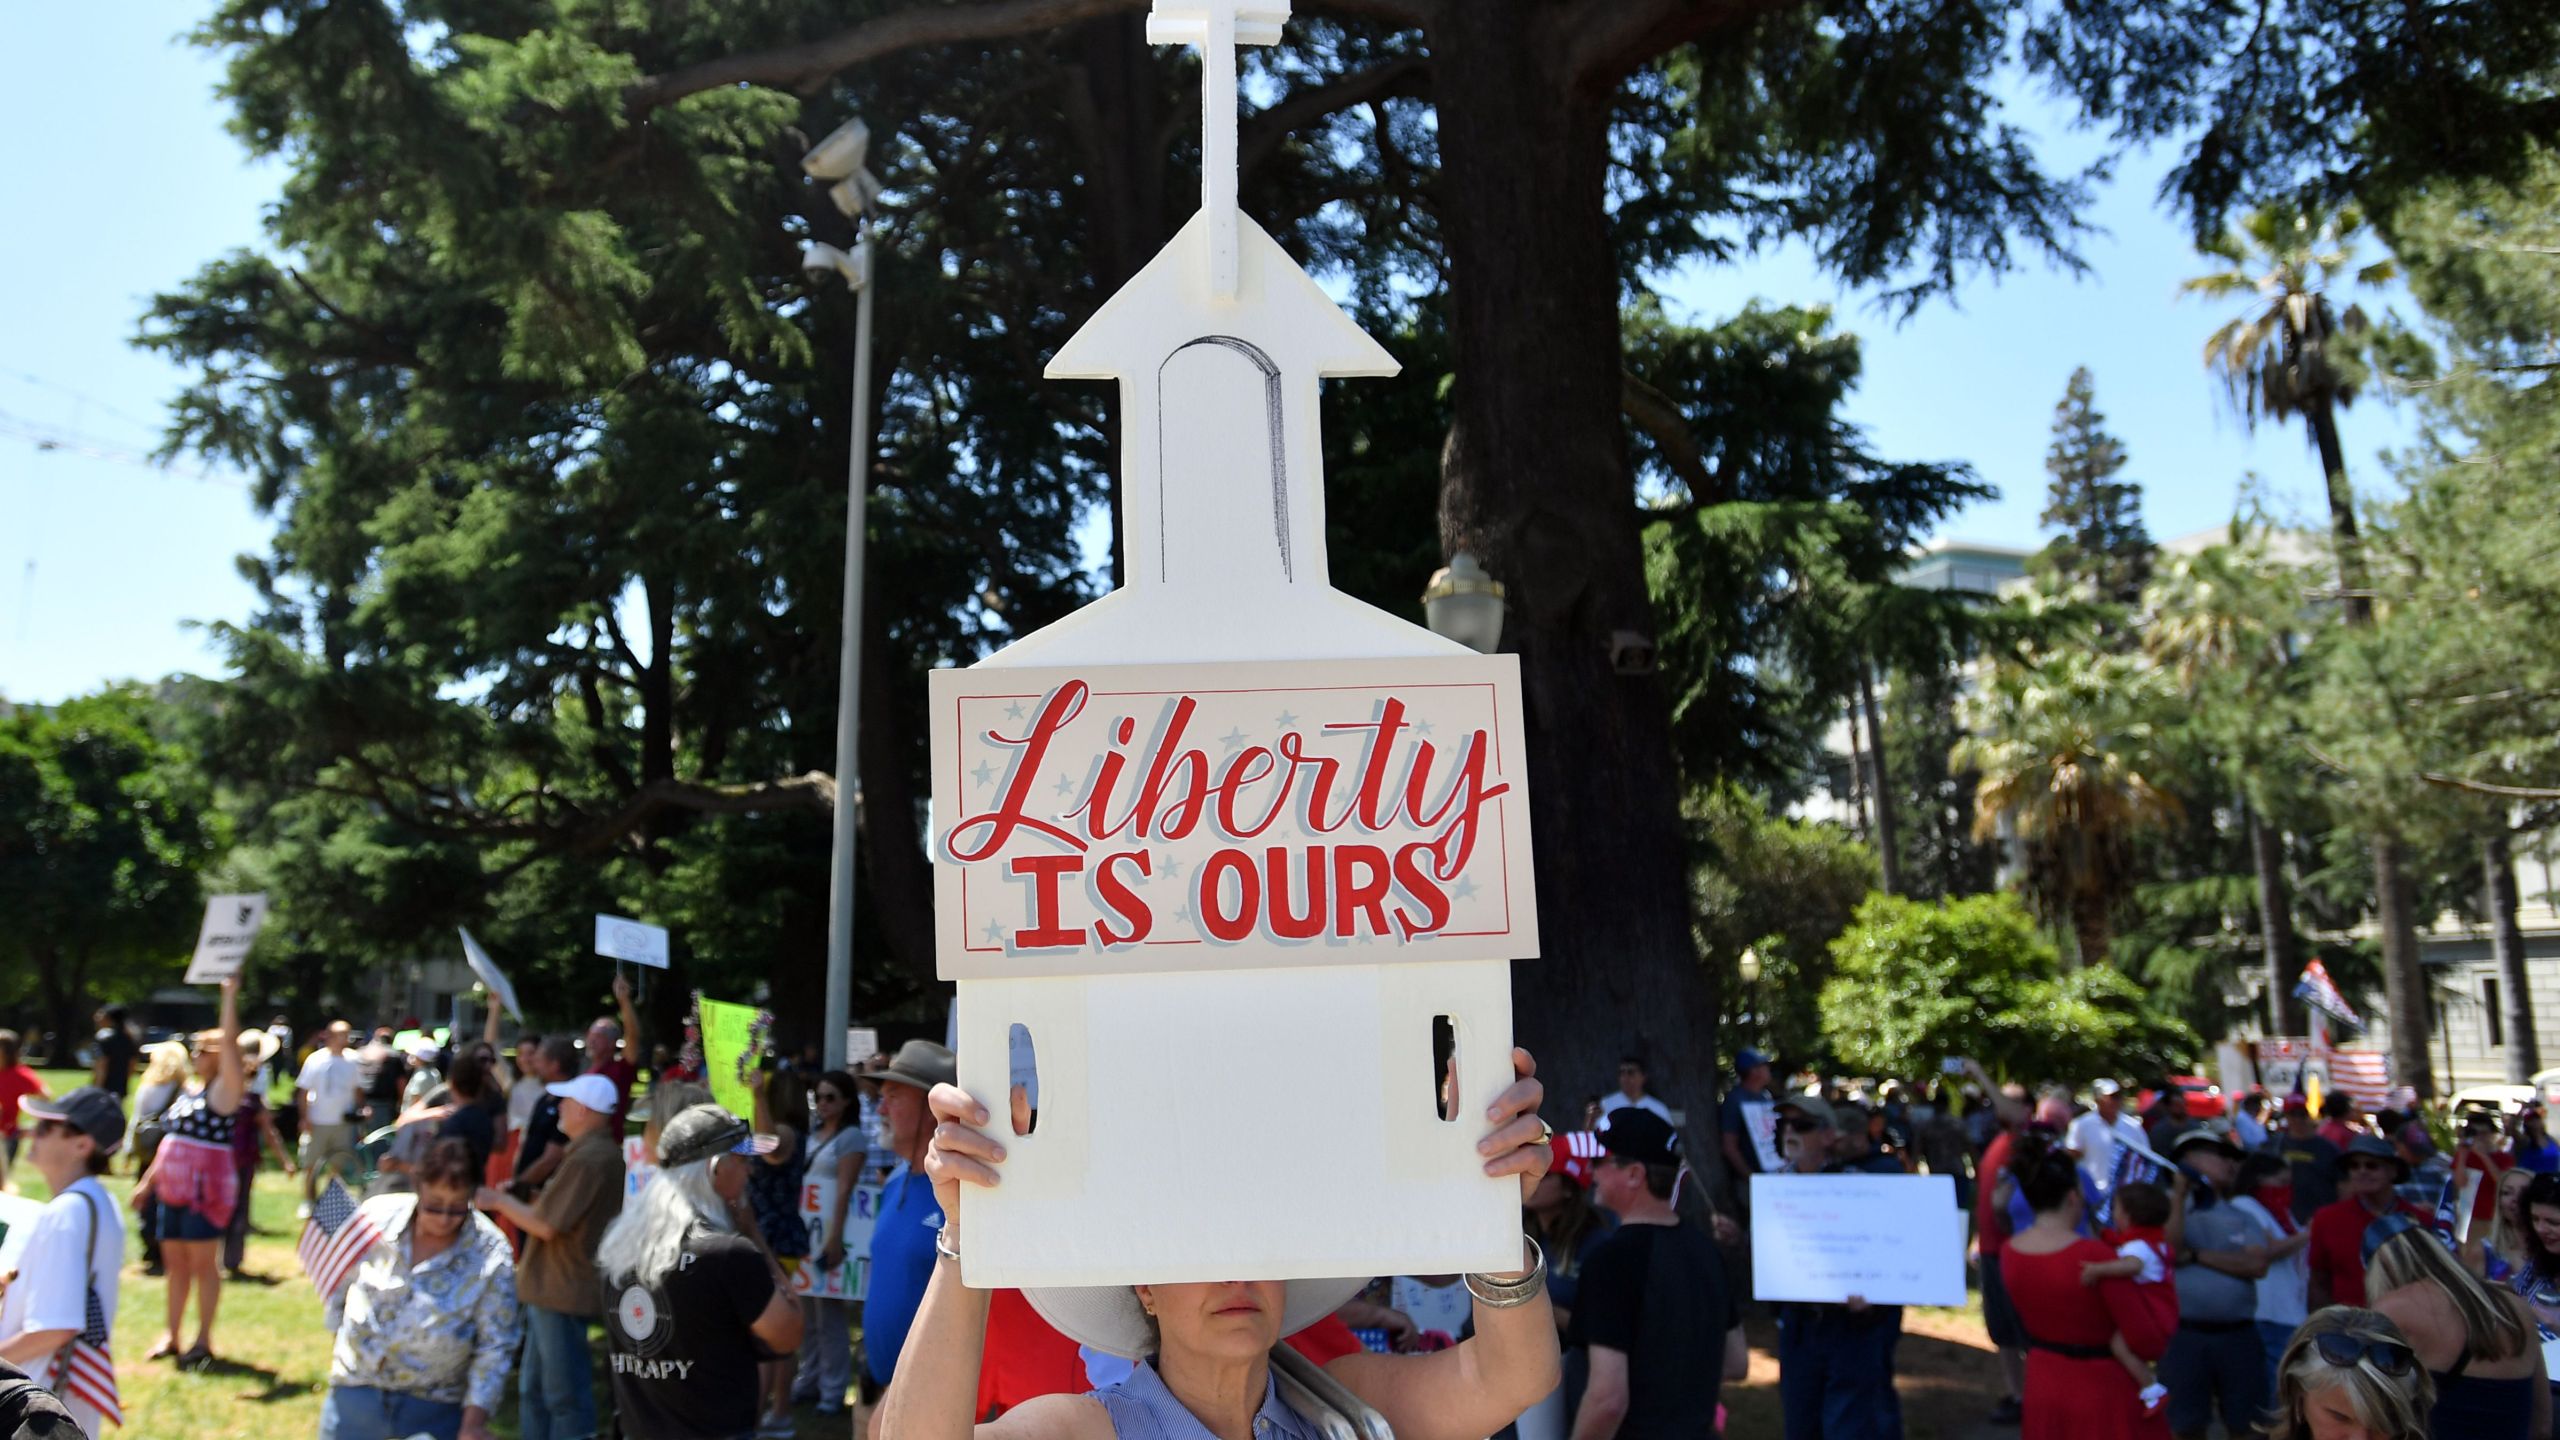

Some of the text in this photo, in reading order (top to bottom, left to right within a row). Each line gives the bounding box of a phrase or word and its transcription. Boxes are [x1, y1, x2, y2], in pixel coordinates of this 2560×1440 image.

[947, 679, 1510, 881] Liberty
[1011, 842, 1451, 949] IS OURS
